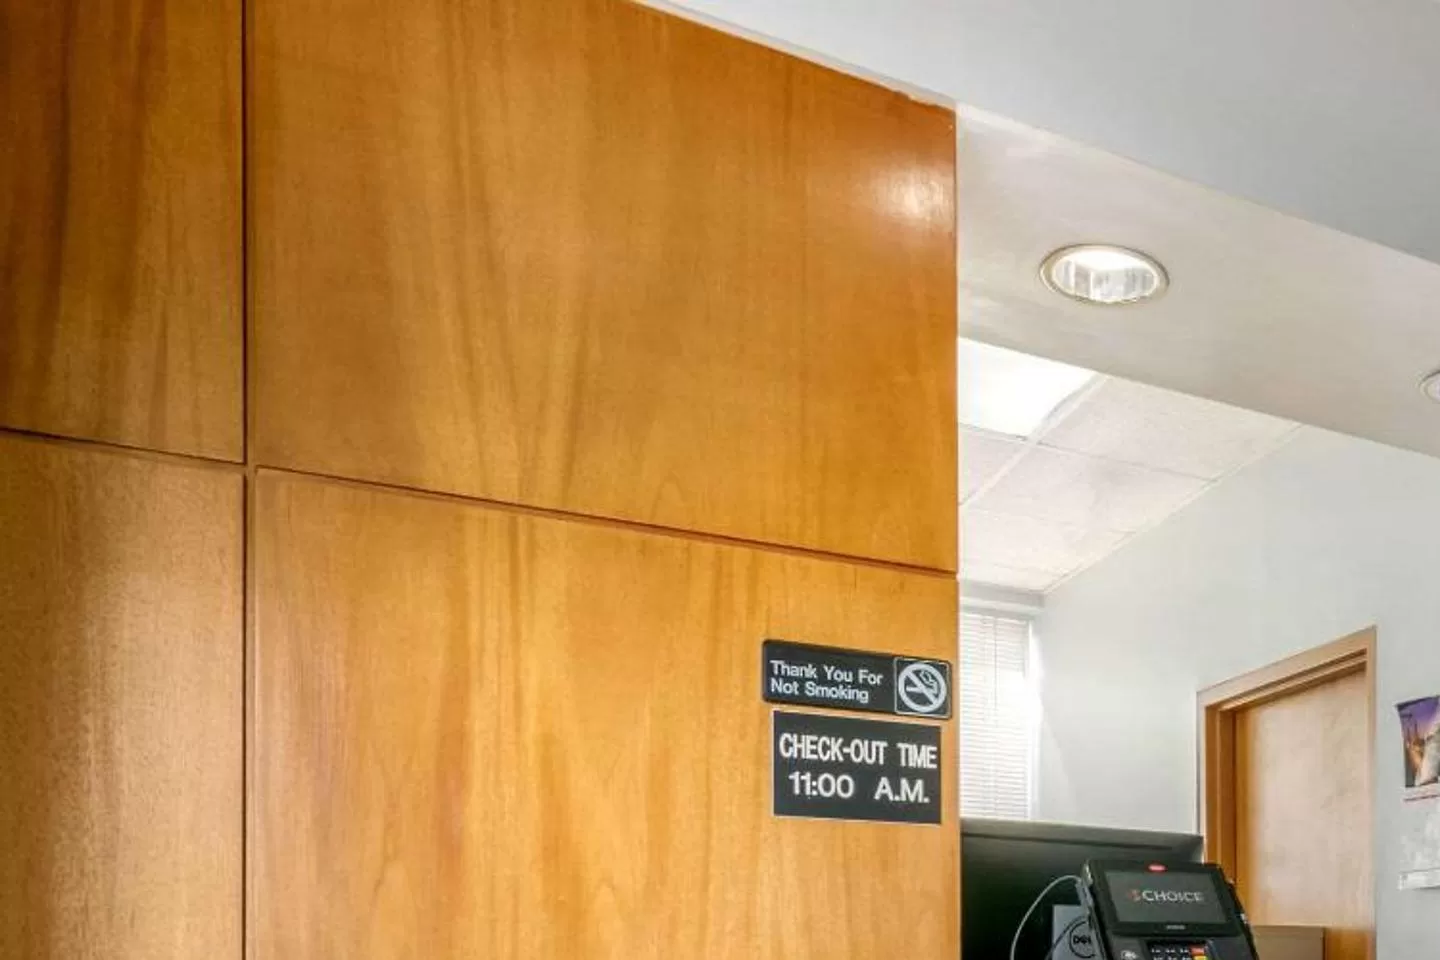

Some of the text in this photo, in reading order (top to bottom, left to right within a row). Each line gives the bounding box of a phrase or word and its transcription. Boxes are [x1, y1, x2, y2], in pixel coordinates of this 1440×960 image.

[769, 659, 884, 686] Thank You For
[769, 677, 869, 704] Not Smoking
[779, 732, 938, 769] CHECK-OUT TIME
[788, 771, 931, 804] 11:00 A.M.
[1141, 889, 1204, 902] CHOICE
